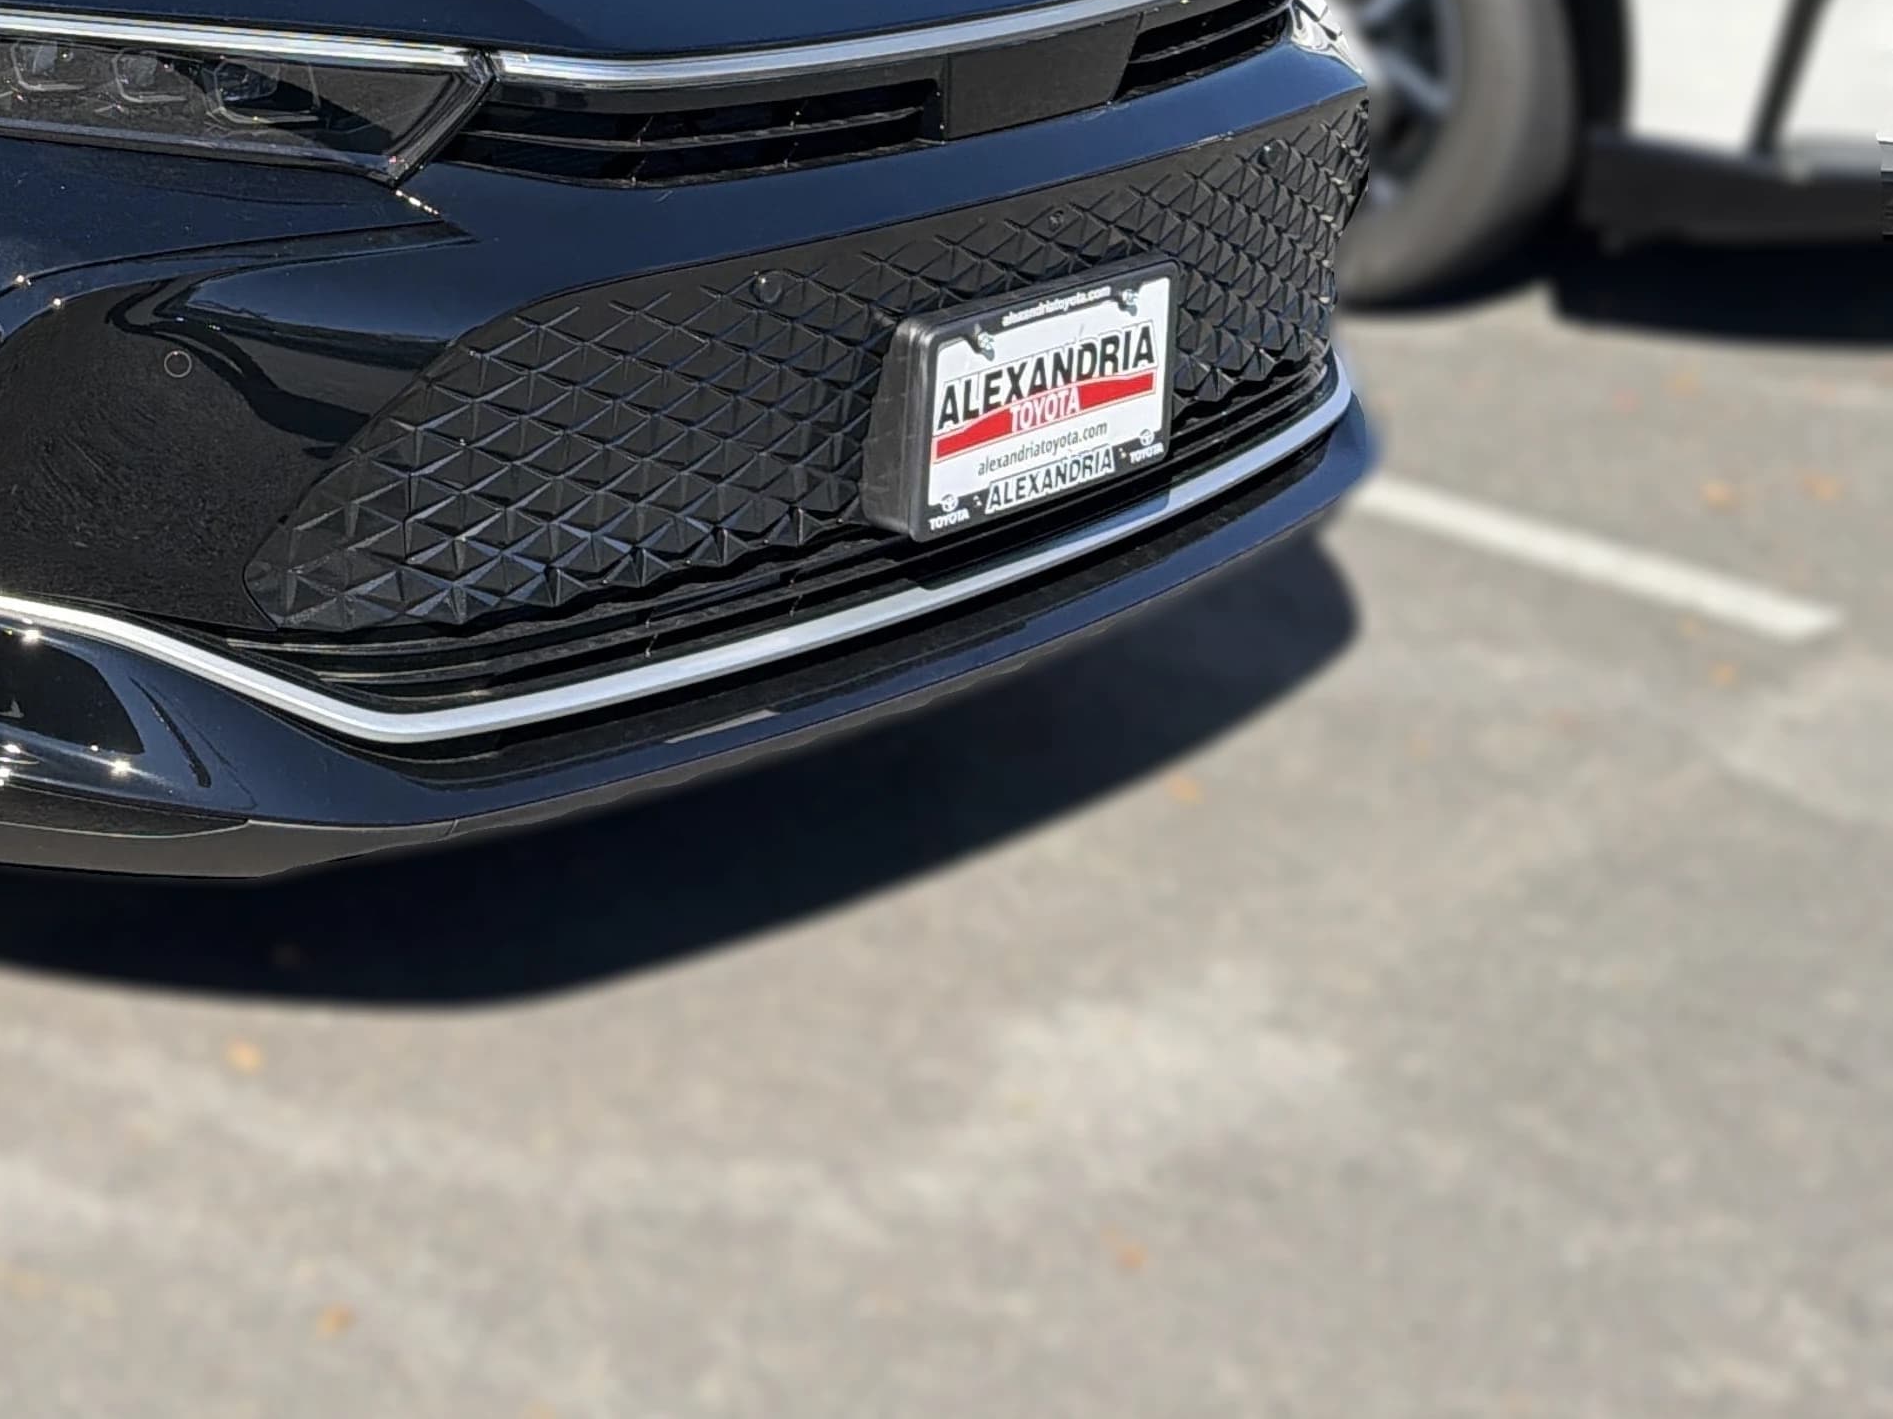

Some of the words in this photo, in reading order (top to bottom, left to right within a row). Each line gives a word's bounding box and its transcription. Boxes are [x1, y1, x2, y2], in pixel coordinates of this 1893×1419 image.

[1002, 286, 1111, 326] alexandriatoyota.com
[937, 325, 1155, 431] ALEXANDRIA
[1011, 386, 1081, 432] TOYOTA
[977, 422, 1108, 476] alexandriatoyota.com
[1129, 442, 1164, 464] TOYOTA
[985, 447, 1113, 512] ALEXANDRIA
[928, 508, 970, 530] TOYOTA
